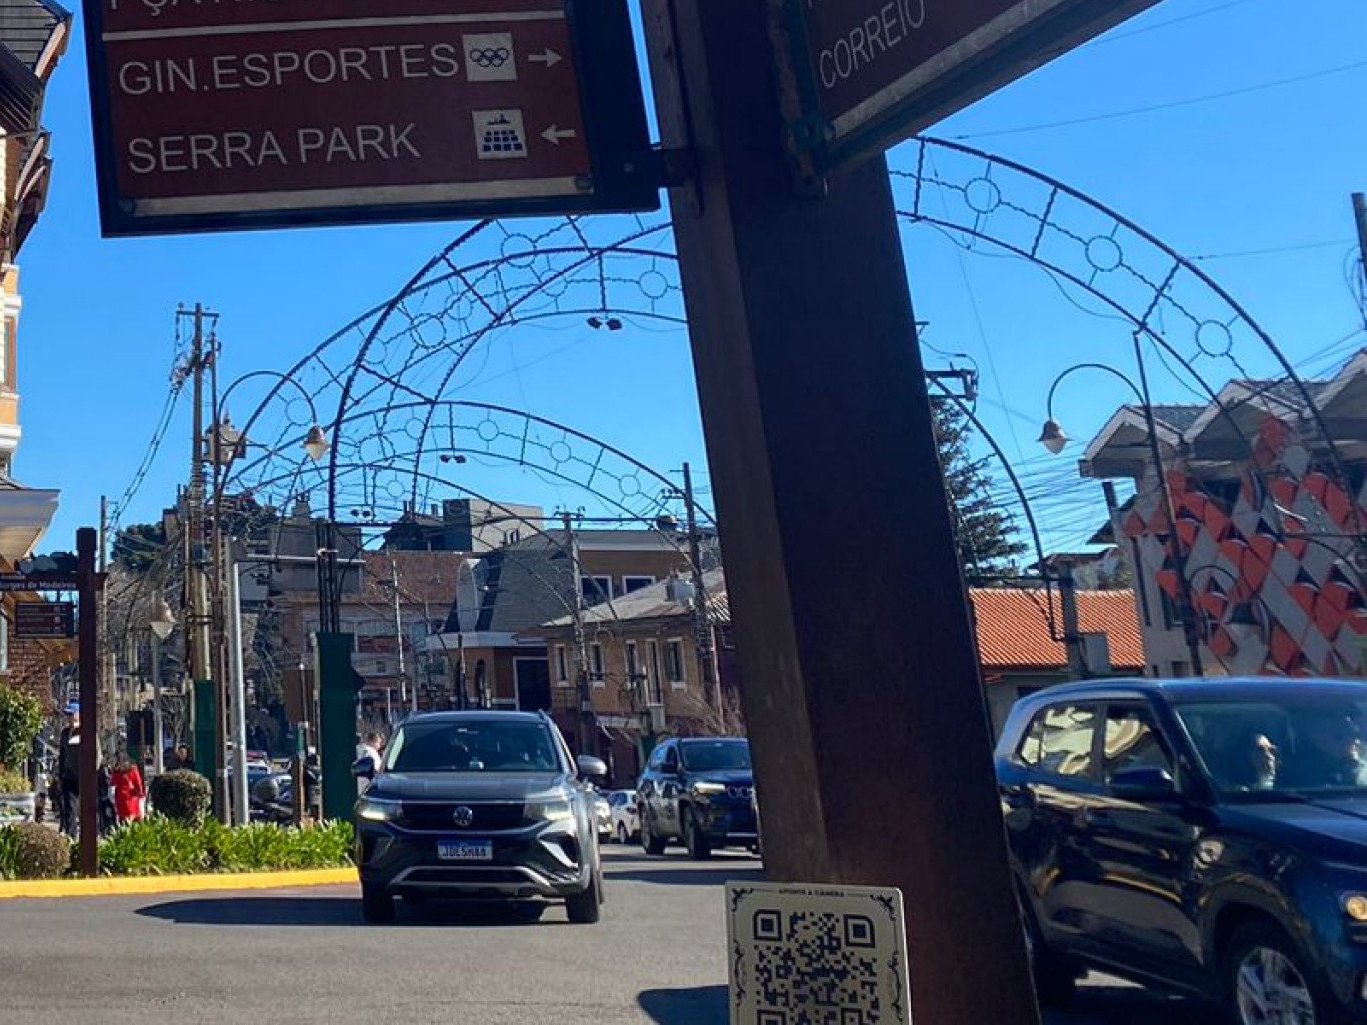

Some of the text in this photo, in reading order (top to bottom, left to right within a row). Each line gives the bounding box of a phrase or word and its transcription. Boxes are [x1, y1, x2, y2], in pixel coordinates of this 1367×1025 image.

[118, 43, 460, 95] GIN.ESPORTES
[127, 122, 422, 174] SERRA PARK
